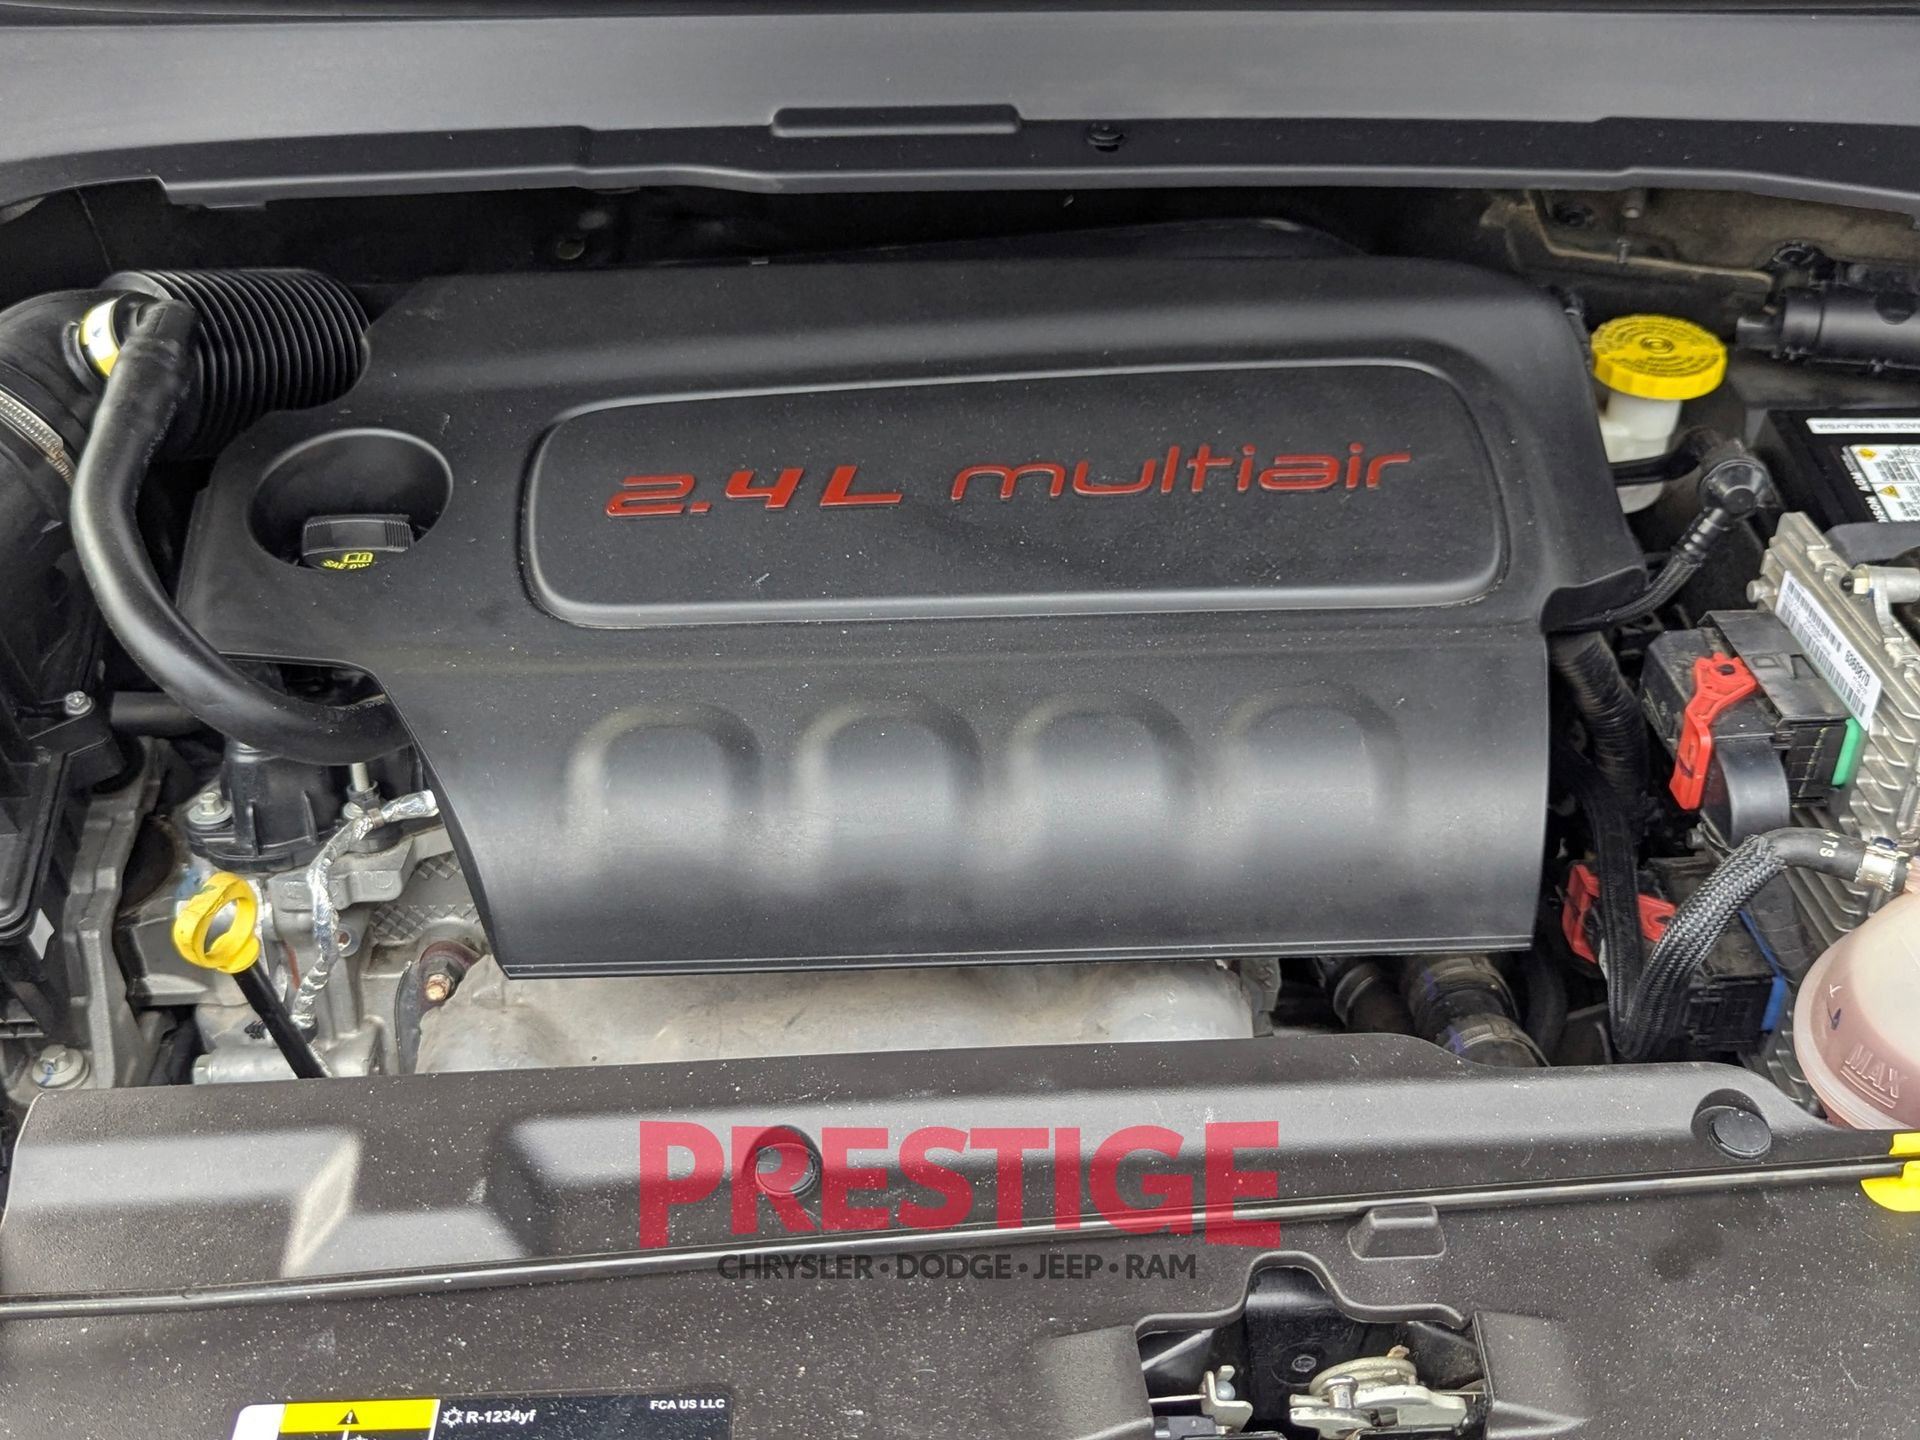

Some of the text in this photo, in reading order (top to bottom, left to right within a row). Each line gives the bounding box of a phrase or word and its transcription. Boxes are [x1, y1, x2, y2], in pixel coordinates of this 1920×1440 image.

[950, 442, 1412, 503] multiair
[1844, 1043, 1906, 1099] MAX
[465, 1409, 537, 1426] R-1234yf
[650, 1398, 726, 1411] FCA US LLC
